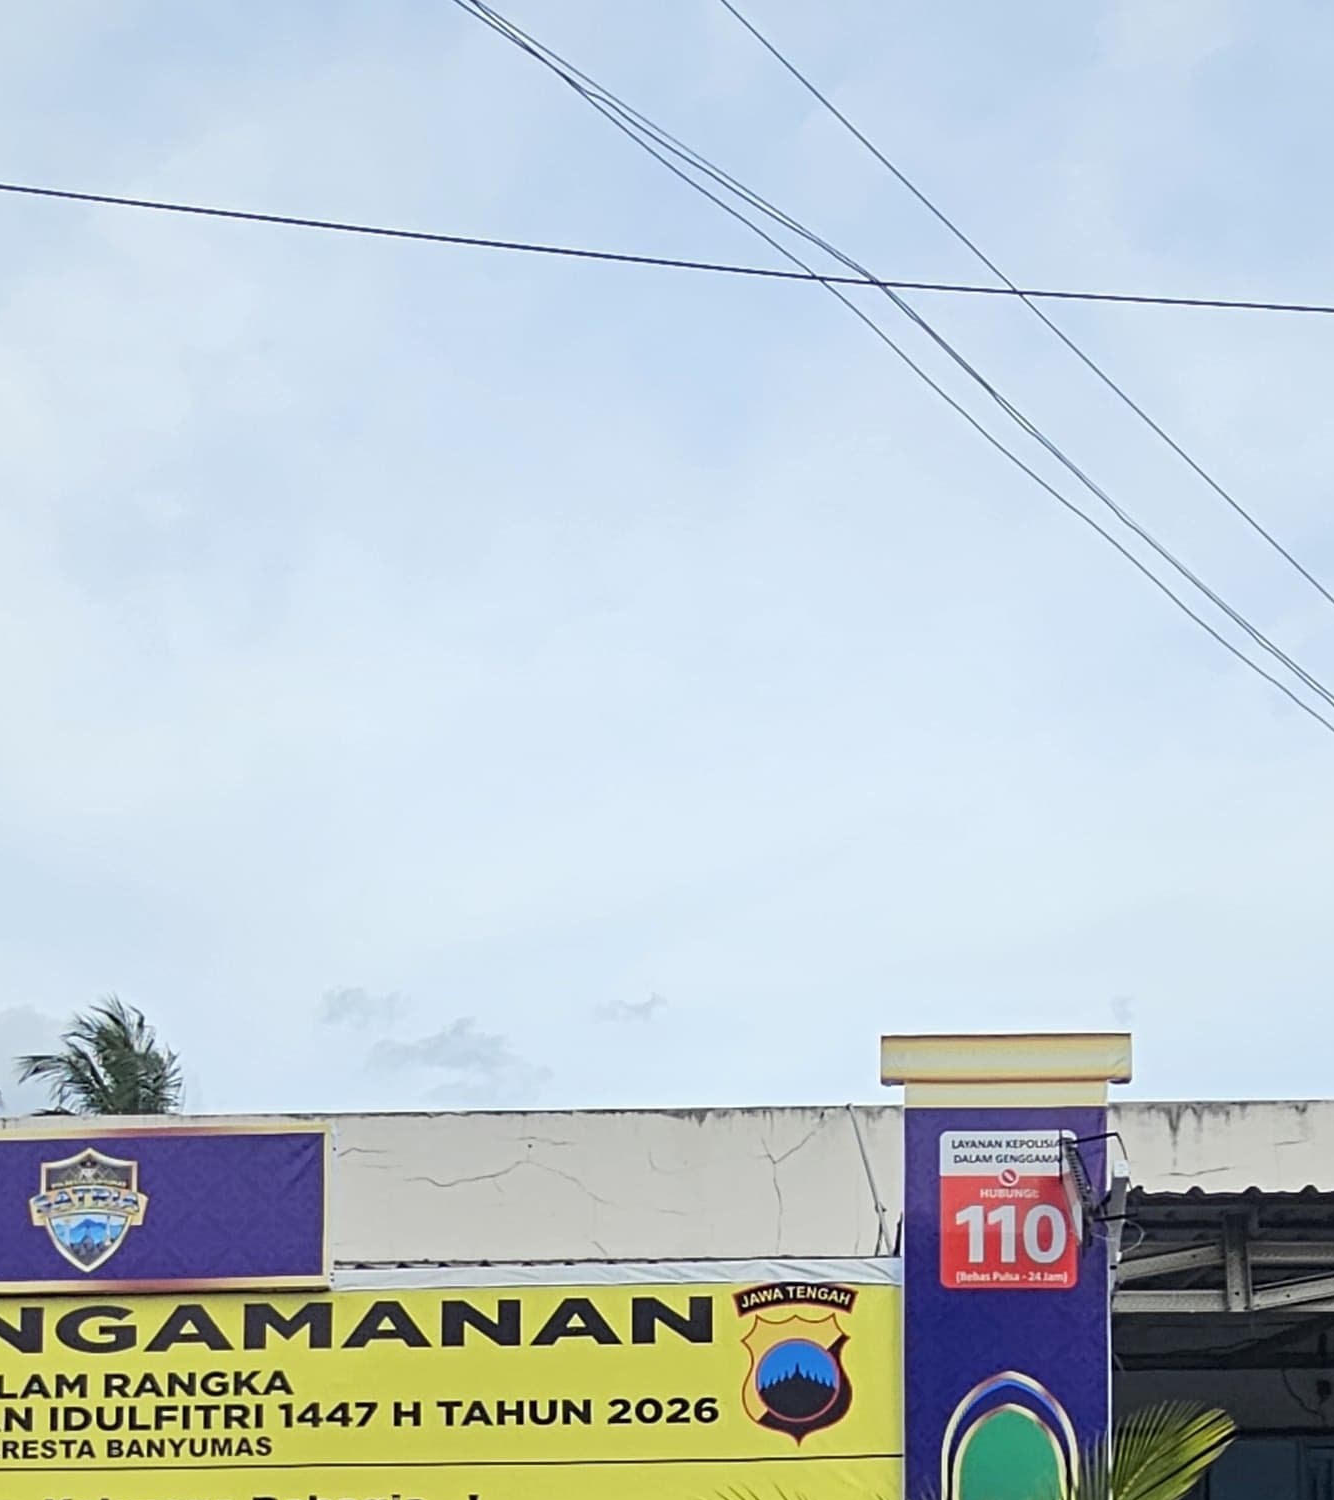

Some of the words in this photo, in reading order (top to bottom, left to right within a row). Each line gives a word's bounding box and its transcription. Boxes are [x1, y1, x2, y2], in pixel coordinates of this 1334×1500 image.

[951, 1139, 1003, 1150] LAYANAN
[1006, 1138, 1061, 1149] KEPOLISIA
[953, 1154, 993, 1164] DALAM
[995, 1153, 1061, 1164] GENGGAMA
[955, 1203, 1067, 1264] 110
[993, 1271, 1020, 1283] Pulsa
[1028, 1271, 1042, 1282] 24
[1043, 1271, 1069, 1283] Jam)
[740, 1287, 785, 1309] JAWA
[784, 1284, 852, 1306] TENGAH
[104, 1370, 294, 1400] RANGKA
[49, 1404, 264, 1433] IDULFITRI
[278, 1401, 379, 1430] 1447
[393, 1402, 424, 1428] H
[436, 1399, 594, 1428] TAHUN
[607, 1396, 720, 1426] 2026
[105, 1436, 274, 1460] BANYUMAS
